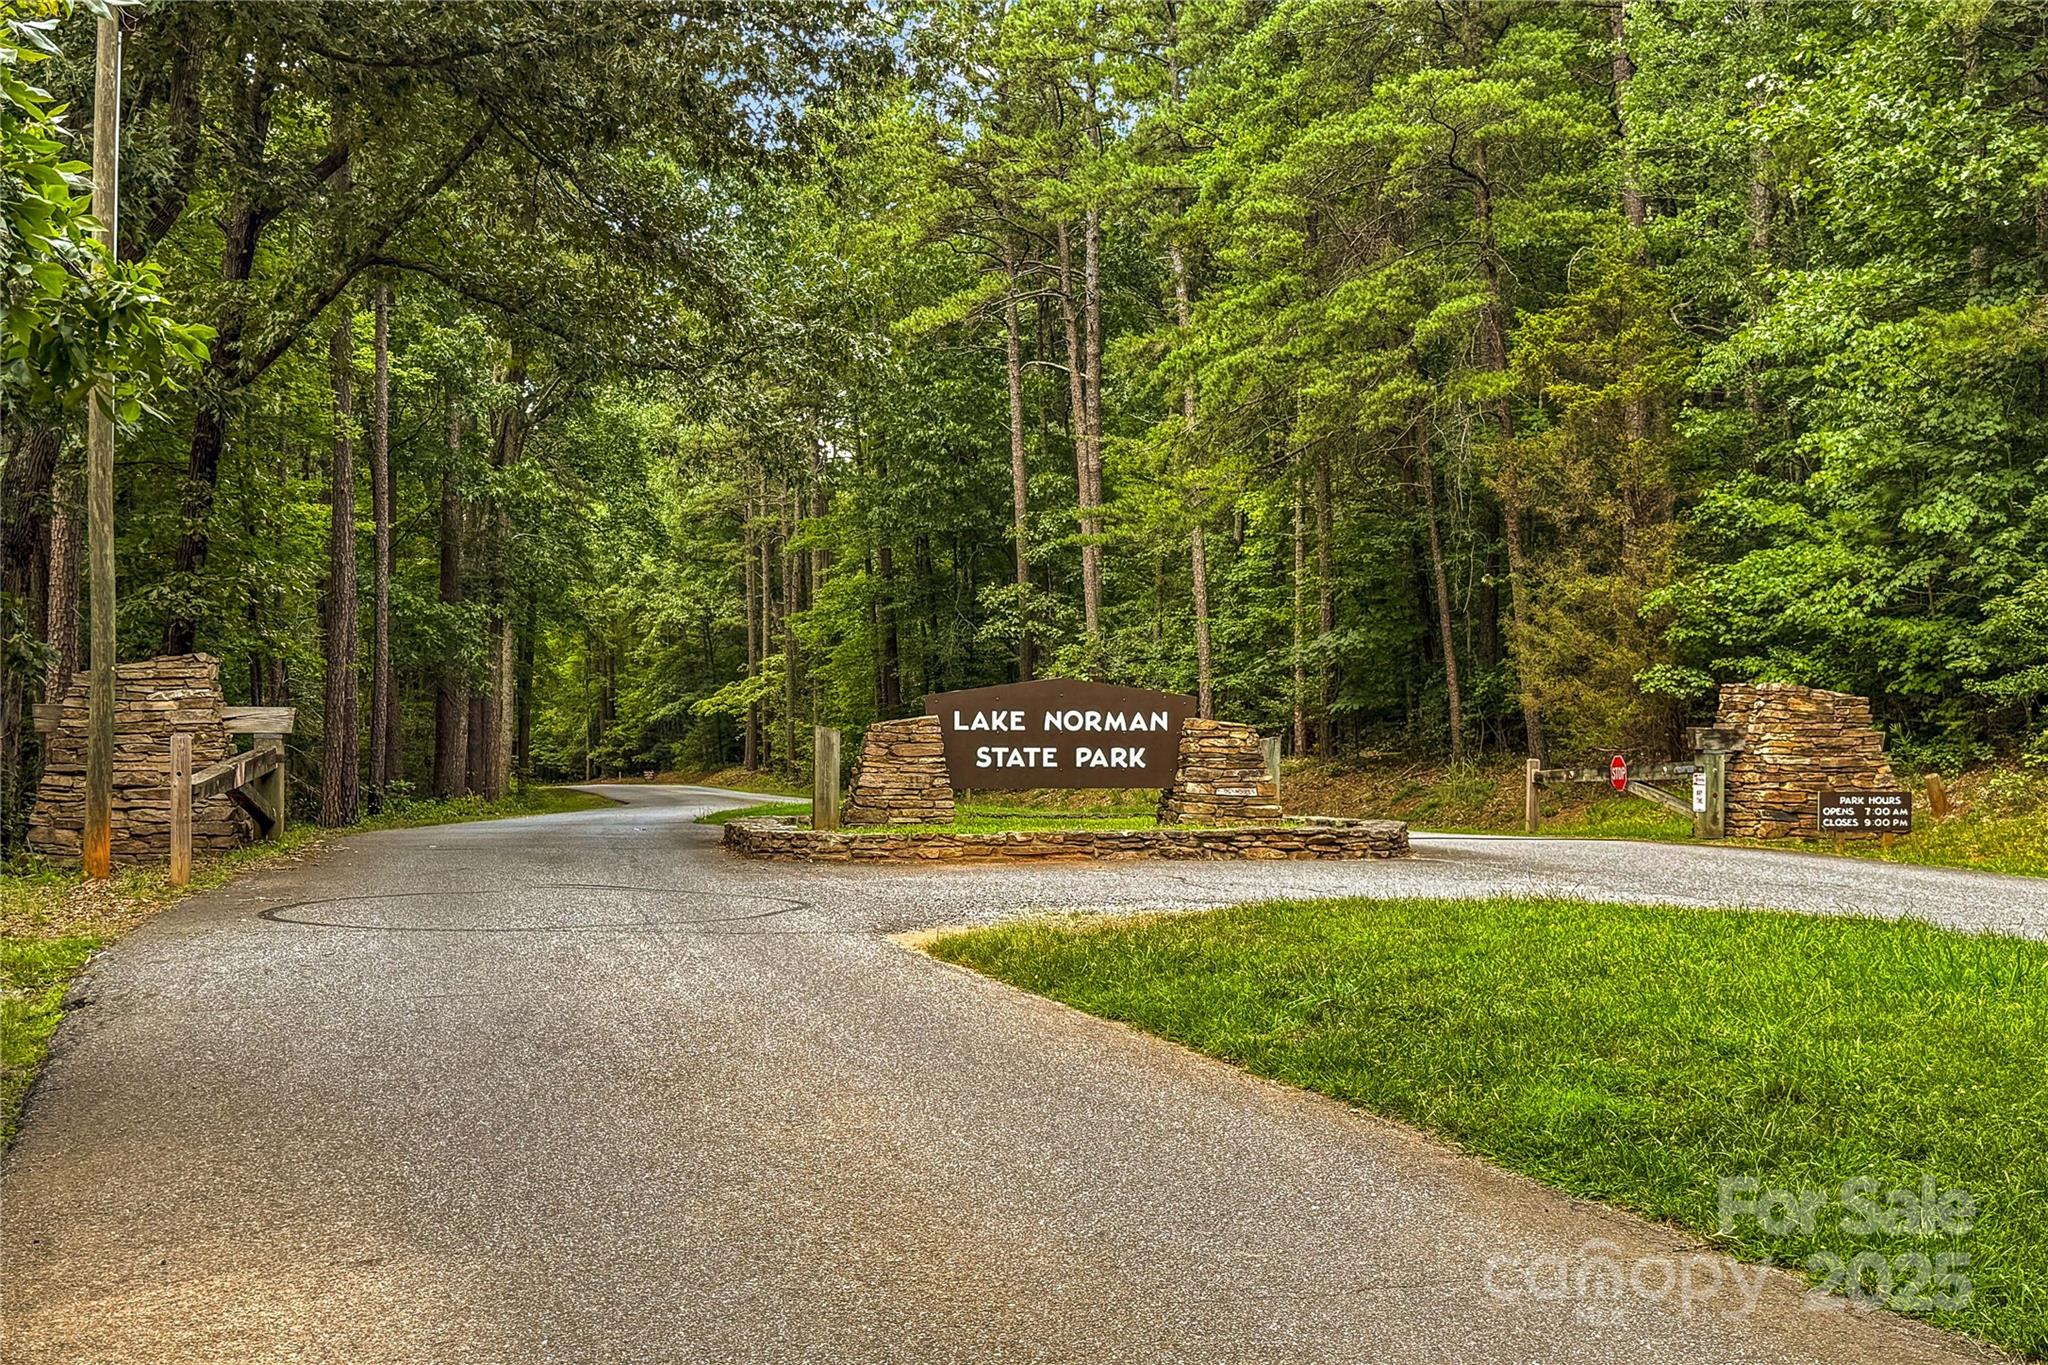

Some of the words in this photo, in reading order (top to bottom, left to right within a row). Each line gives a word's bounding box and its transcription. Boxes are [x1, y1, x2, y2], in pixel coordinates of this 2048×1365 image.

[952, 710, 1026, 732] LAKE
[1043, 710, 1168, 732] NORMAN
[975, 746, 1058, 768] STATE
[1075, 747, 1147, 769] PARK
[1612, 767, 1626, 780] STOP
[1839, 796, 1864, 805] PARK
[1868, 796, 1901, 805] HOURS
[1822, 807, 1855, 816] OPENS
[1864, 807, 1890, 816] 7:00
[1892, 807, 1908, 816] AM
[1822, 818, 1859, 827] CLOSES
[1864, 818, 1890, 827] 9:00
[1892, 818, 1908, 827] PM
